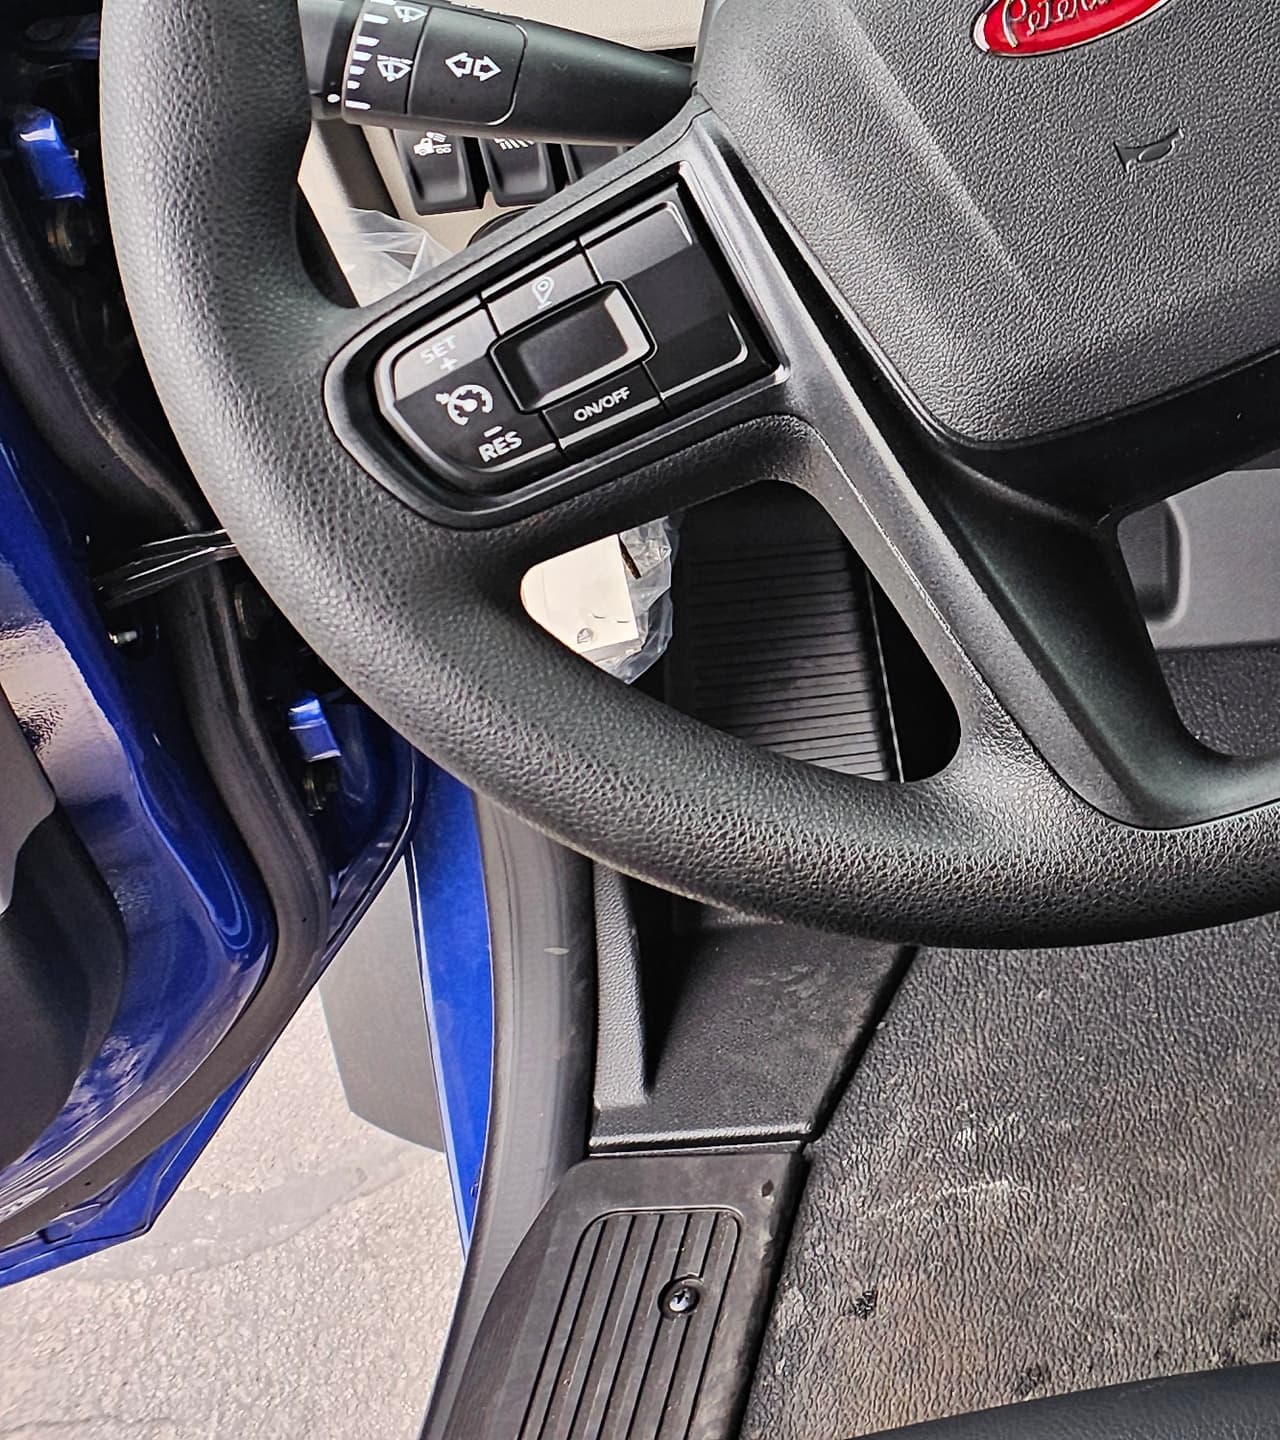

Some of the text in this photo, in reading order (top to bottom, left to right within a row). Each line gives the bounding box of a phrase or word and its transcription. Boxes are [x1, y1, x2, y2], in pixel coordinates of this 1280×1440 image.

[420, 335, 457, 363] SET
[574, 386, 631, 422] ON/OFF
[478, 430, 522, 462] RES
